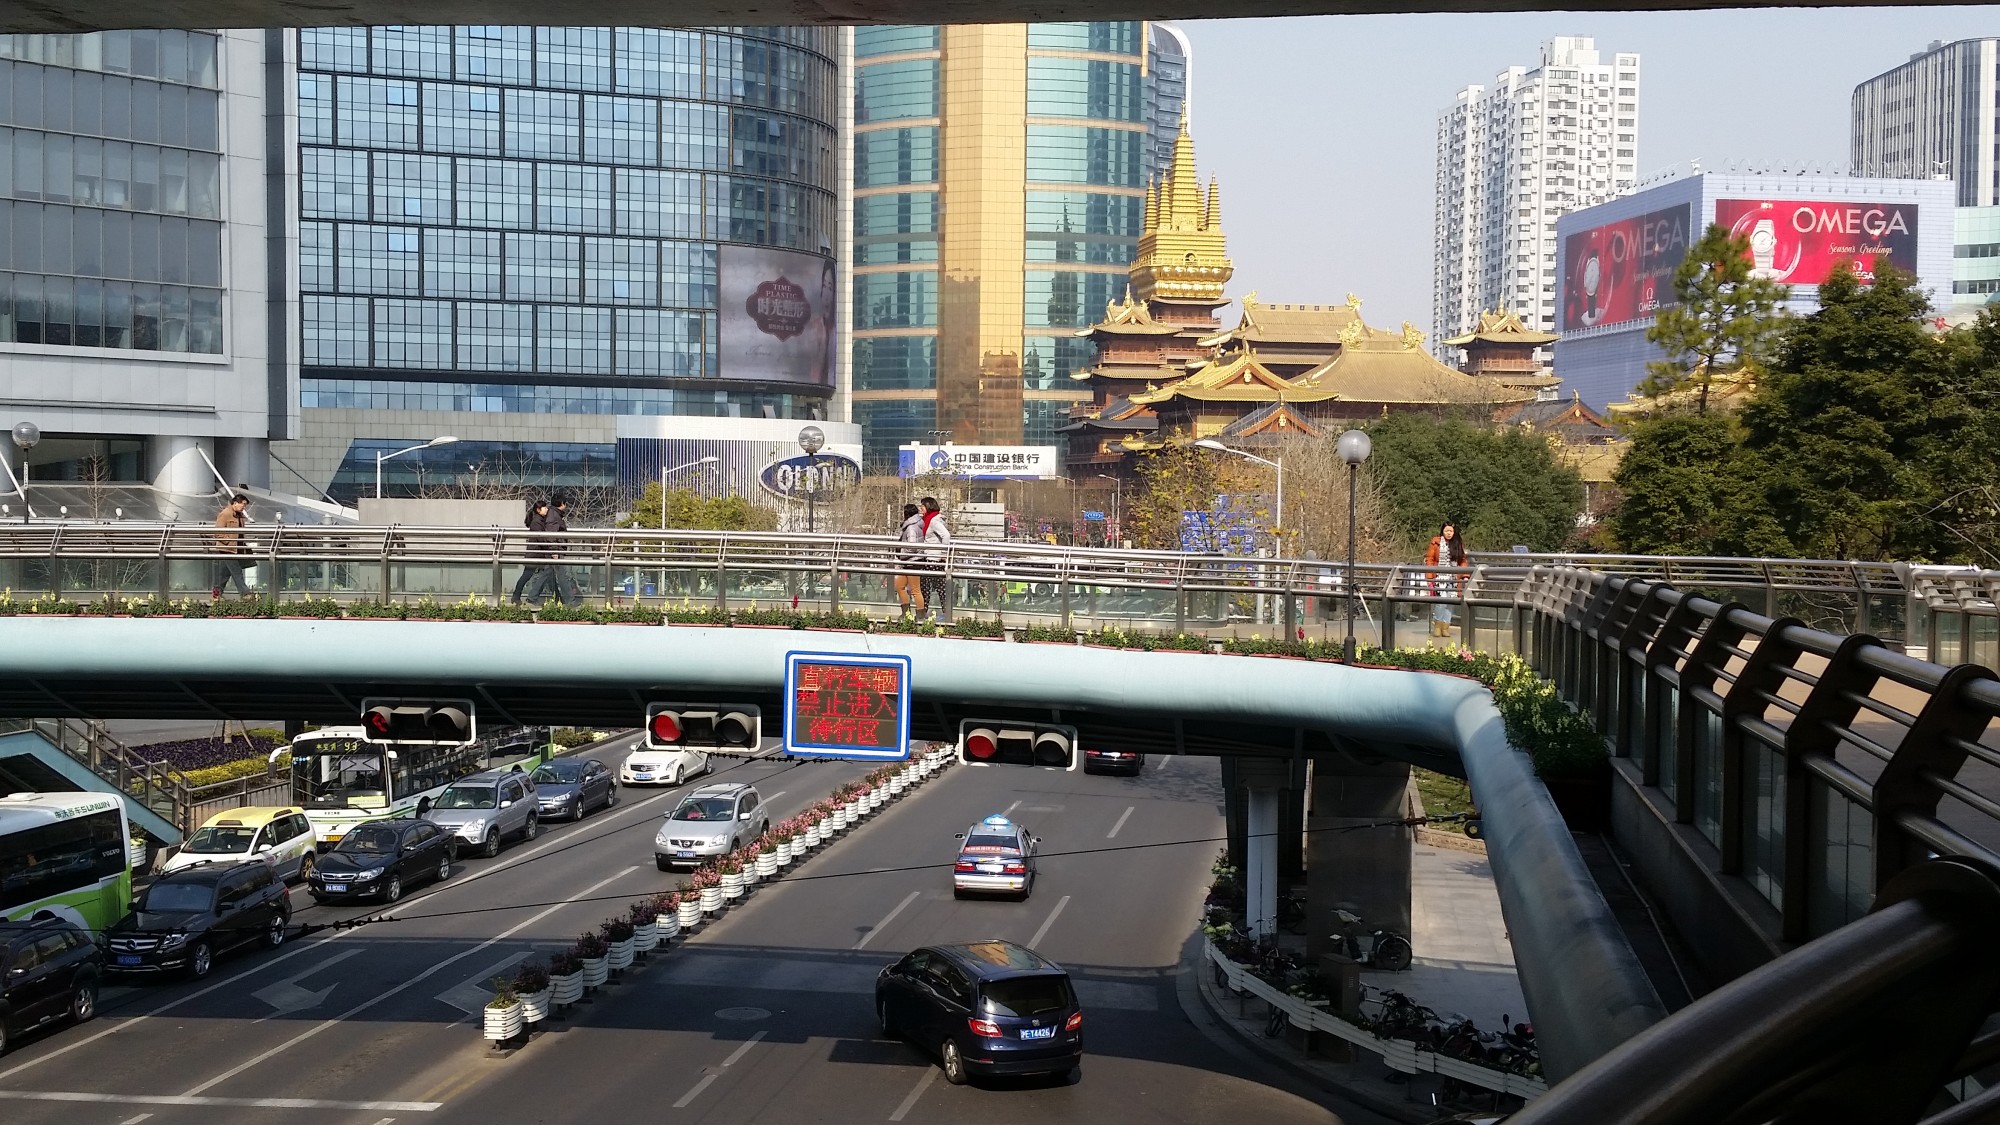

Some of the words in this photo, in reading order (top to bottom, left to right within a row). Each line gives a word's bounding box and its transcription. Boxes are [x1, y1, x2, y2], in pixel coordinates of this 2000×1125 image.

[1792, 207, 1909, 235] OMEGA
[1612, 216, 1685, 263] OMEGA
[1828, 242, 1856, 255] Season's
[1859, 241, 1893, 254] Greetings
[766, 290, 797, 299] PLASTIC
[773, 284, 792, 292] TIME
[1638, 300, 1660, 312] OMEGA
[954, 453, 1040, 464] 中国建设银行
[801, 665, 898, 694] 直行车辆
[796, 690, 897, 718] 禁止进入
[809, 716, 880, 744] 待行区
